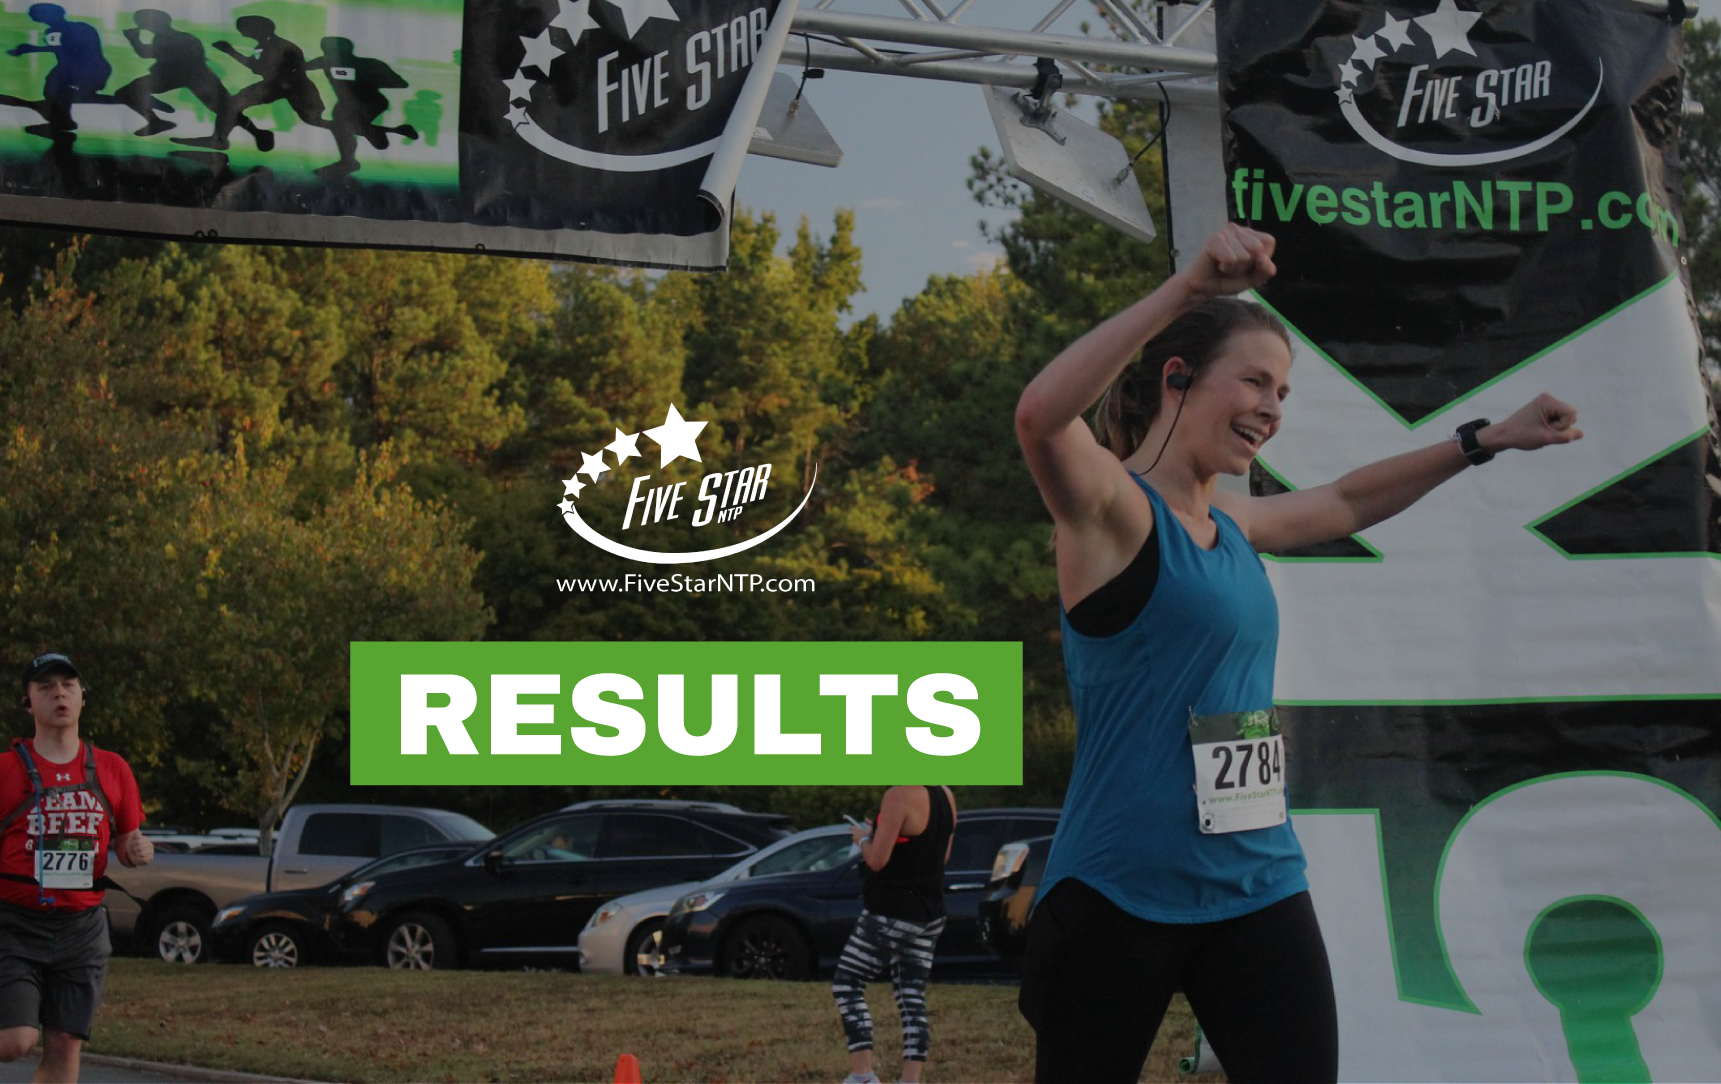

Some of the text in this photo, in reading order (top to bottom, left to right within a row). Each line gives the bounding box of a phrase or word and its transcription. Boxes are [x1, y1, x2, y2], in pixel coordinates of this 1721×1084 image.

[597, 50, 669, 134] FIVE
[1397, 60, 1552, 128] FIVE STAR
[1211, 740, 1281, 790] 2784
[30, 790, 104, 814] EAM
[26, 812, 105, 835] BEEF
[43, 852, 89, 871] 2776
